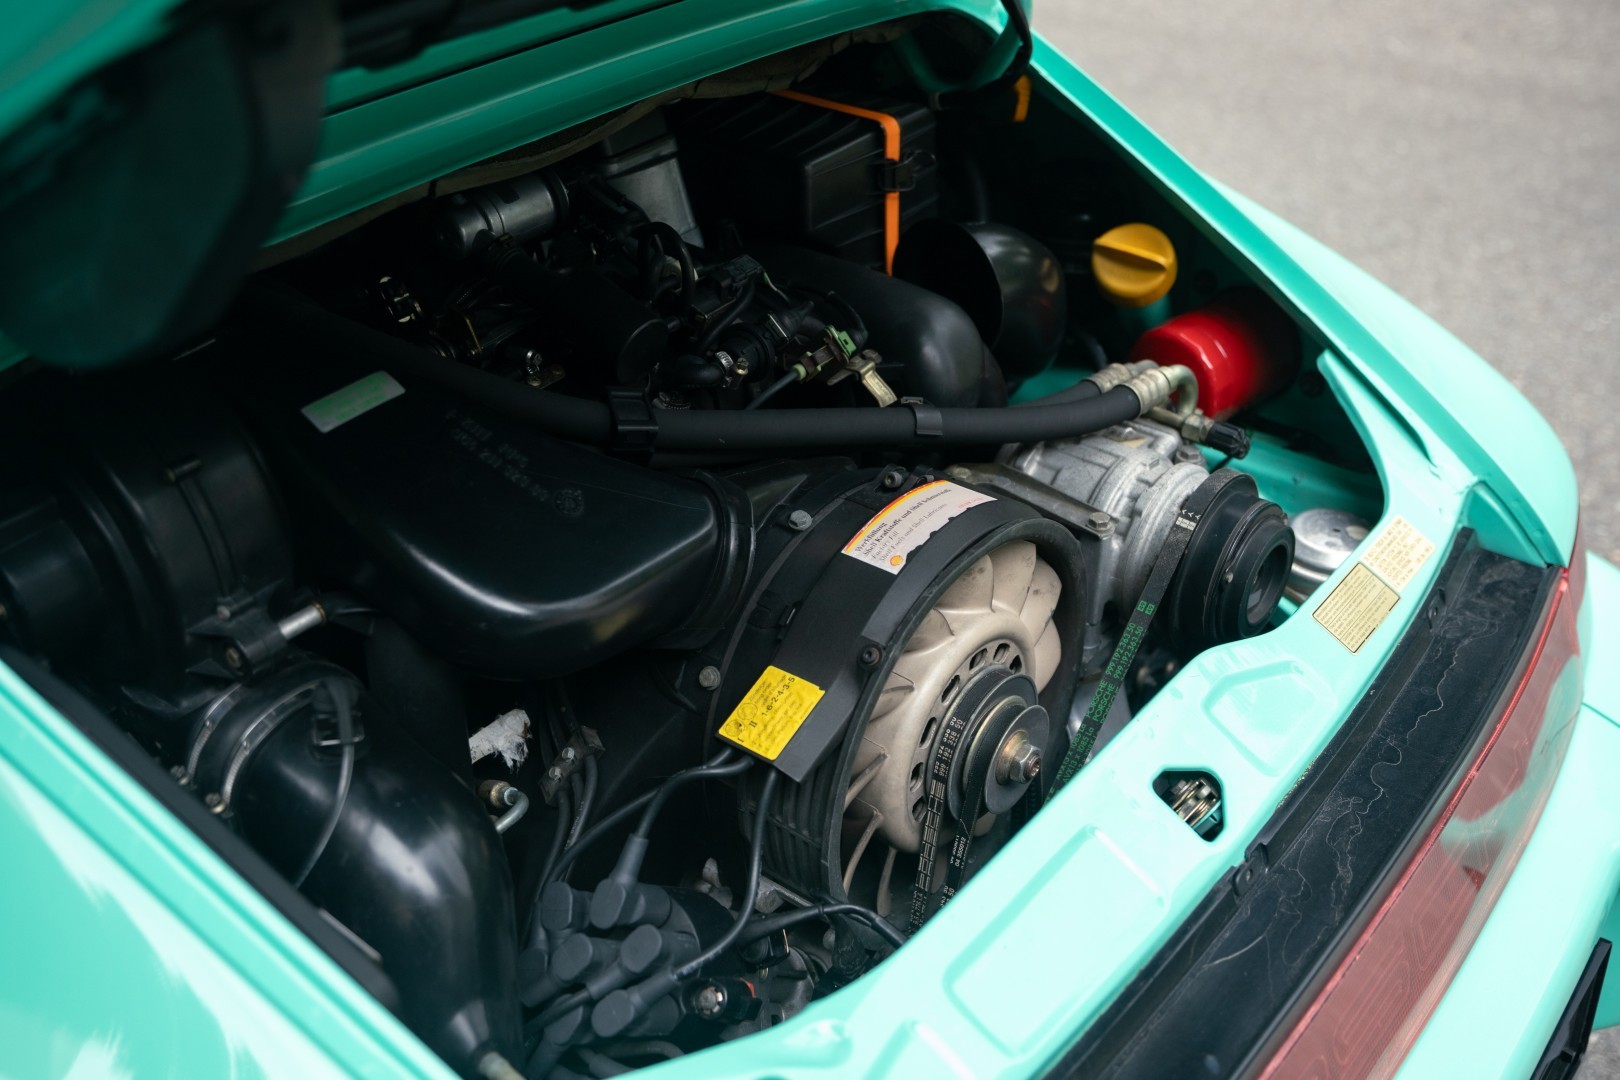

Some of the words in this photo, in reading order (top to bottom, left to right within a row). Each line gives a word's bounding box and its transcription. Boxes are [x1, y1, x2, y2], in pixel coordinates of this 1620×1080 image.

[761, 677, 796, 716] 1-6-2-4-3-5
[1093, 683, 1116, 722] PORSCHE
[1113, 625, 1144, 679] 999.192.363.50
[1085, 679, 1108, 718] PORSCHE
[938, 762, 946, 777] 999
[942, 748, 951, 761] 192
[954, 719, 964, 730] 50
